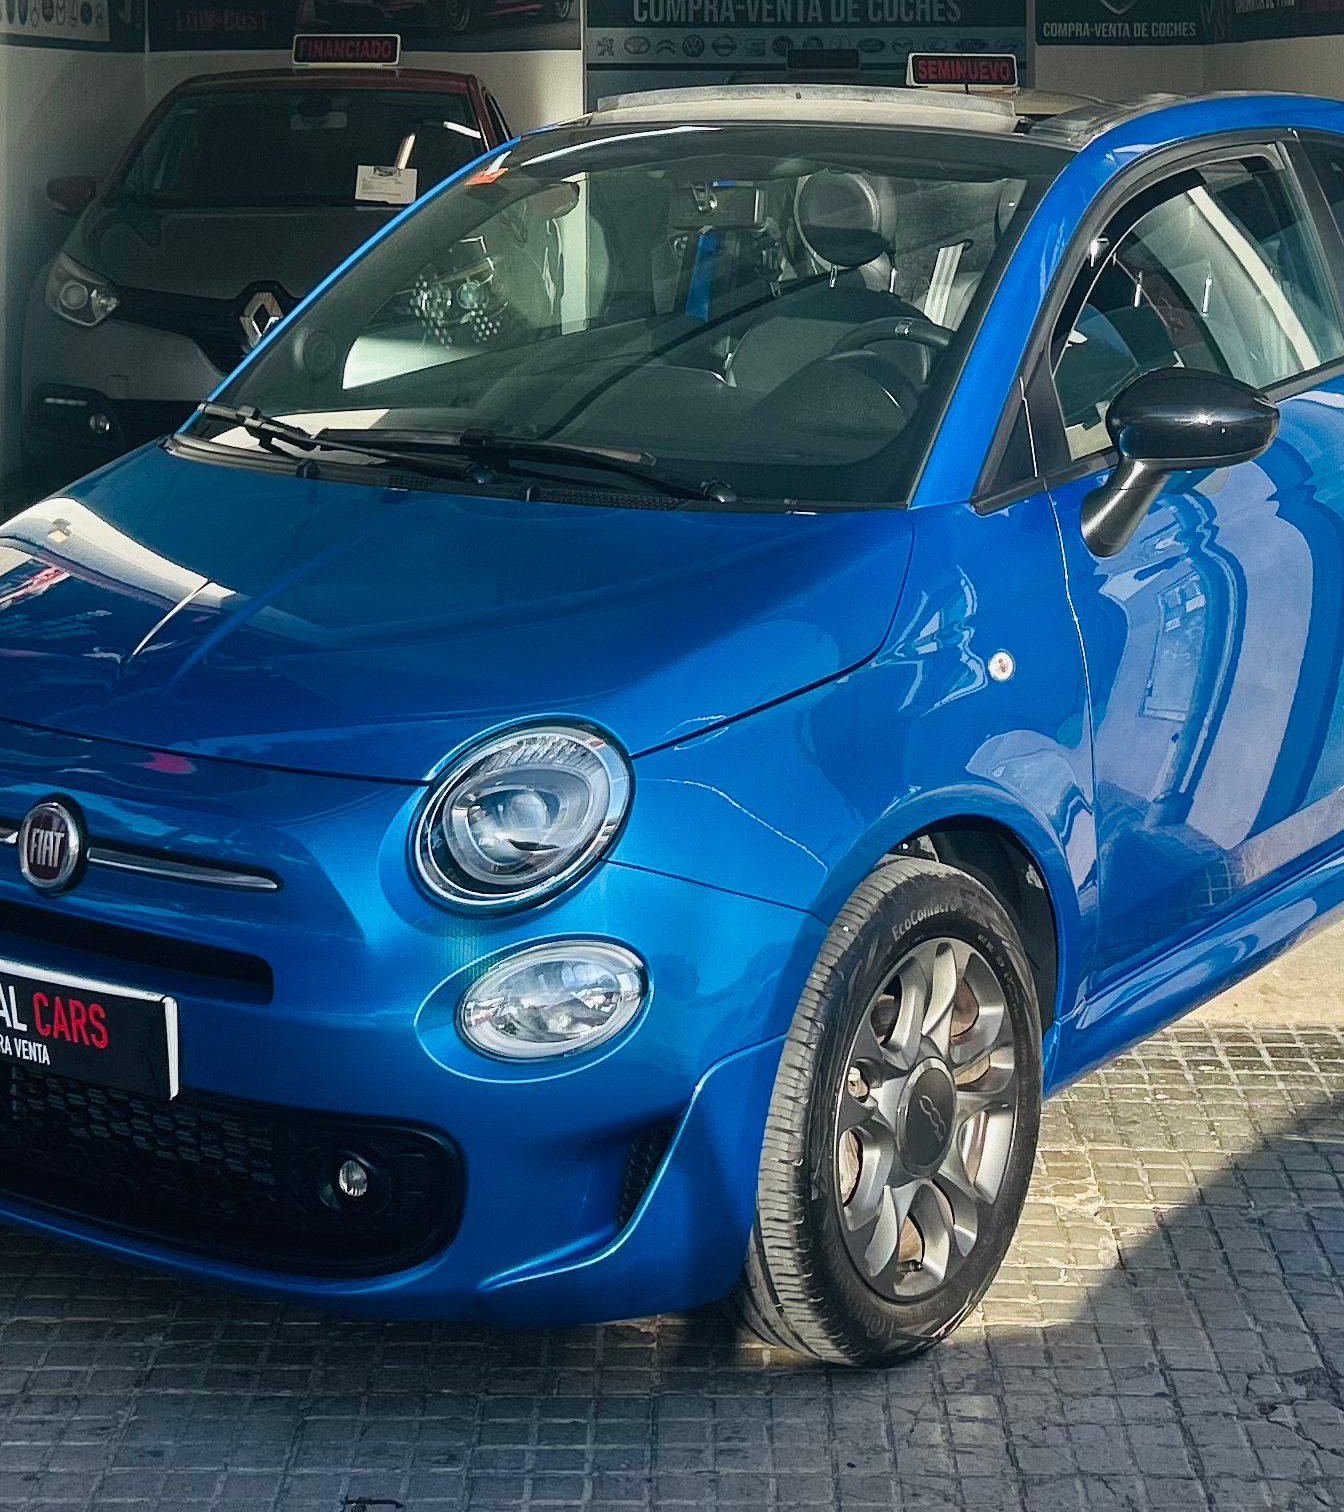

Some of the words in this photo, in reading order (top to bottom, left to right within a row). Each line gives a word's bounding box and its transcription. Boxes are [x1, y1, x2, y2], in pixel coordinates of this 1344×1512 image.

[1043, 22, 1131, 38] COMPRA-VENTA
[1133, 22, 1148, 37] DE
[1151, 21, 1197, 37] COCHES
[299, 39, 393, 60] FINANCIADO
[918, 59, 1011, 82] SEMINUEVO
[28, 827, 65, 868] FIAT
[32, 991, 109, 1050] CARS
[14, 1036, 51, 1066] VENTA
